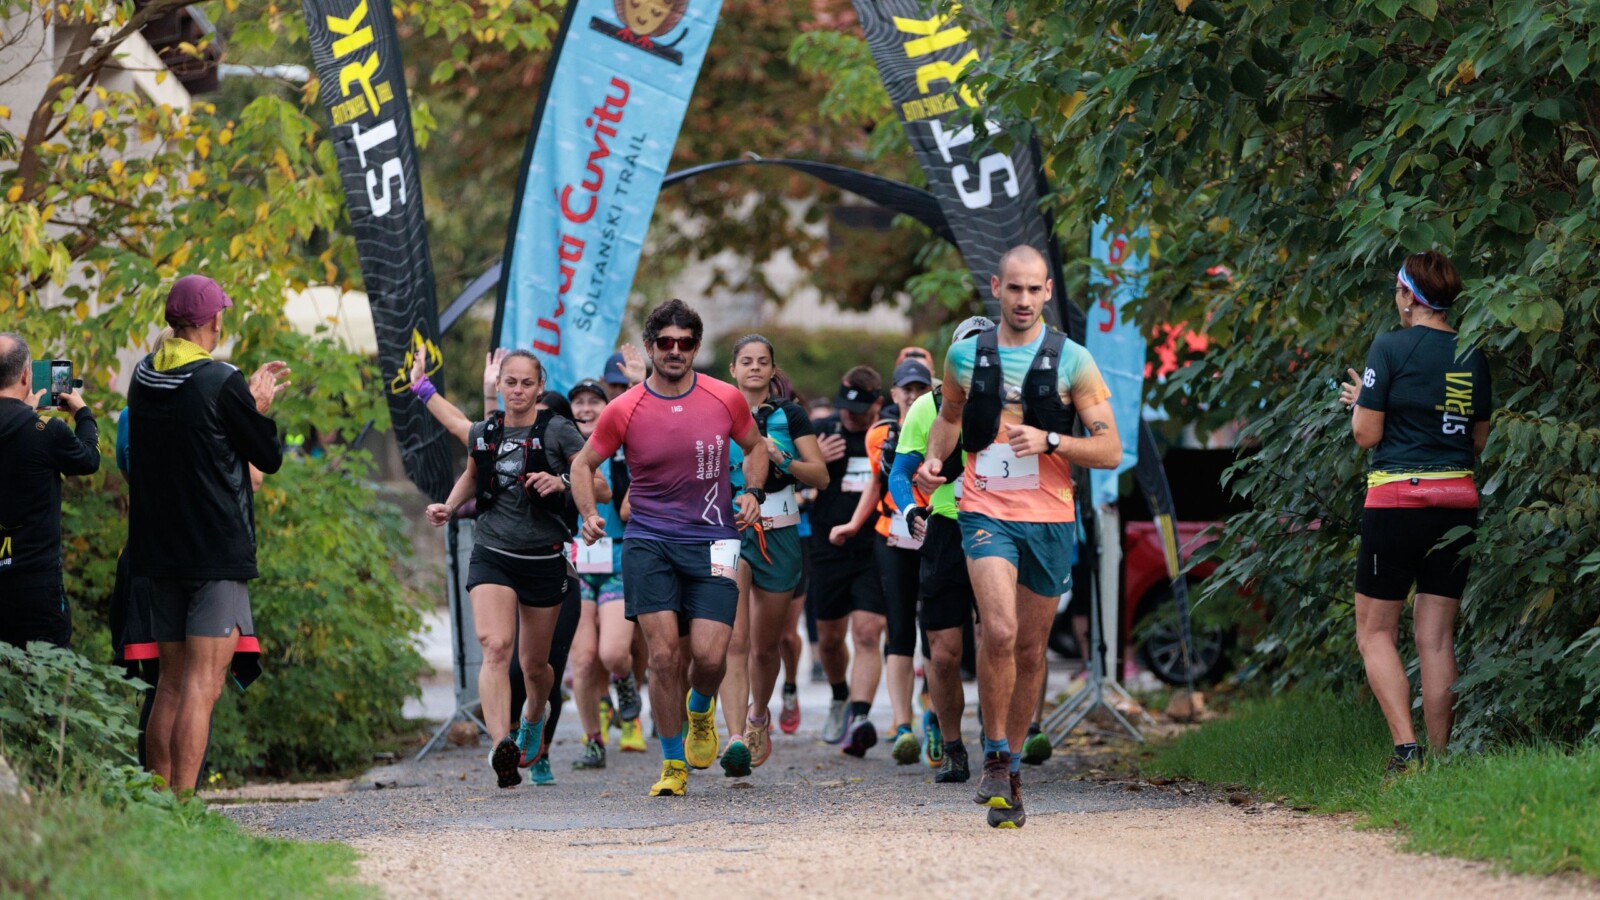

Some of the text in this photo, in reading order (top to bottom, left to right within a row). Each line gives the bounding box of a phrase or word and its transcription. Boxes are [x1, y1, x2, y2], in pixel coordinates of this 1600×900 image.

[573, 132, 647, 331] ŠOLTANSKI TRAIL
[696, 440, 705, 480] Absolute
[705, 444, 715, 479] Biokovo
[713, 434, 724, 478] Challenge
[1002, 460, 1009, 478] 3
[782, 500, 789, 516] 4
